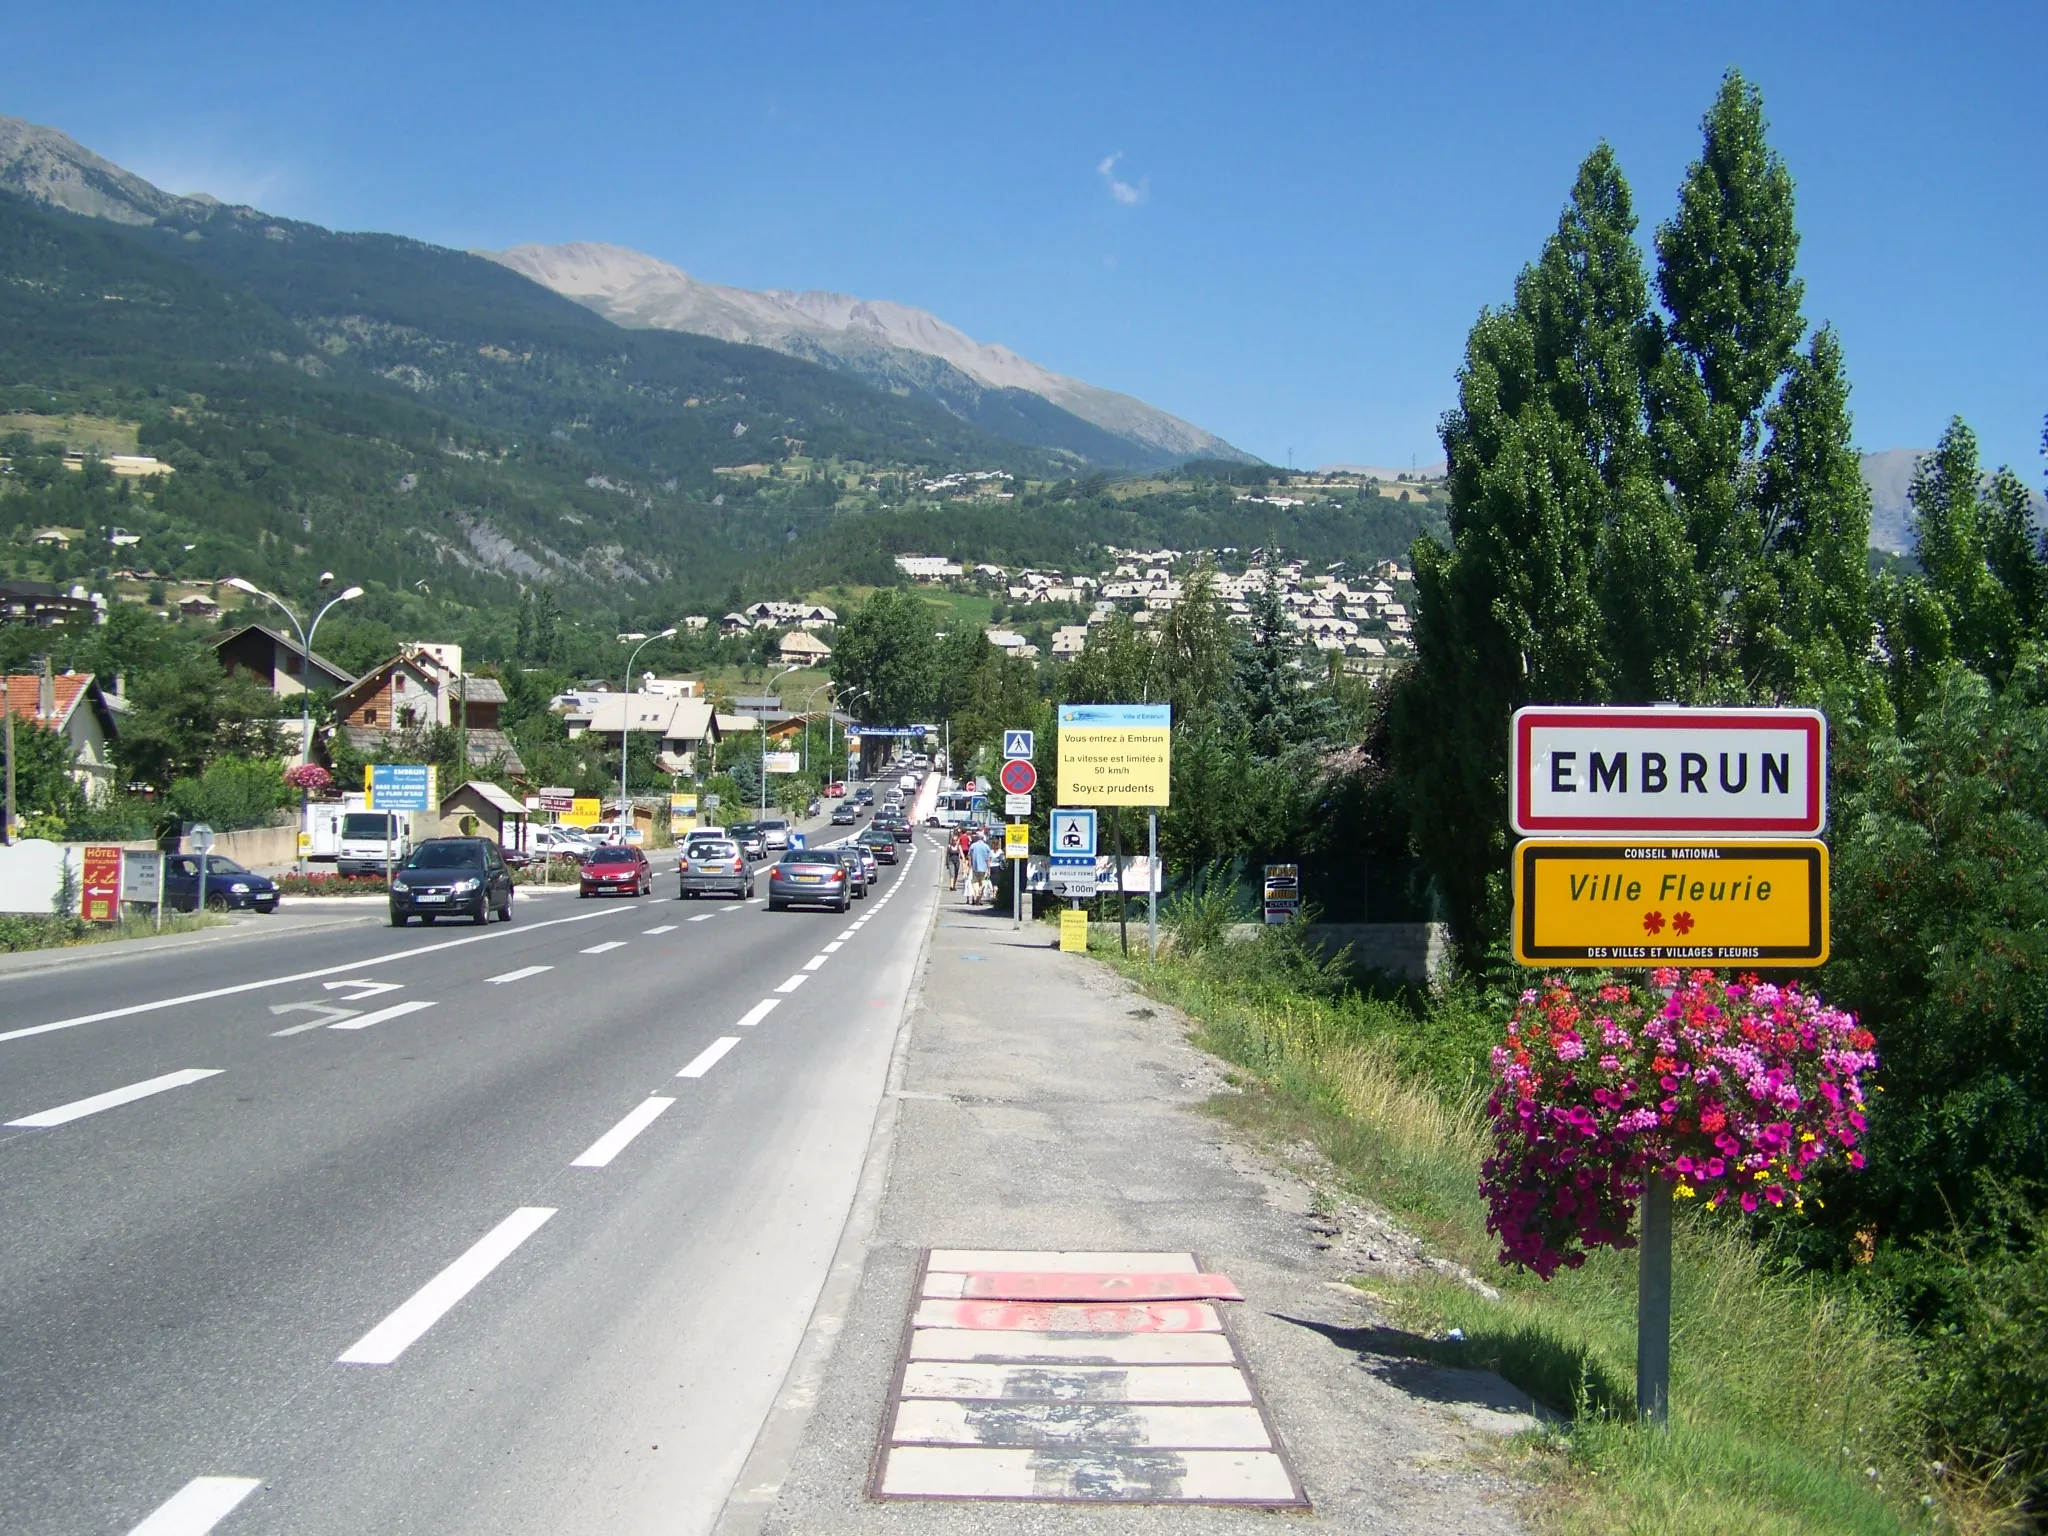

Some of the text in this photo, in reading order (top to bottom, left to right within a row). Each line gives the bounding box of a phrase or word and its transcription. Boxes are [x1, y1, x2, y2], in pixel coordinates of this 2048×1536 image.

[1064, 734, 1086, 742] Vous
[1120, 734, 1125, 742] à
[1128, 734, 1164, 742] Embrun
[1094, 766, 1130, 774] 50 km/h
[1551, 751, 1789, 794] EMBRUN
[1072, 784, 1154, 794] Soyez prudents
[87, 847, 118, 857] HÔTEL
[1624, 849, 1720, 859] CONSEIL NATIONAL
[1071, 885, 1094, 893] 100m
[1570, 874, 1772, 902] Ville Fleurie
[1588, 948, 1759, 958] DES VILLES ET VILLAGES FLEURIS
